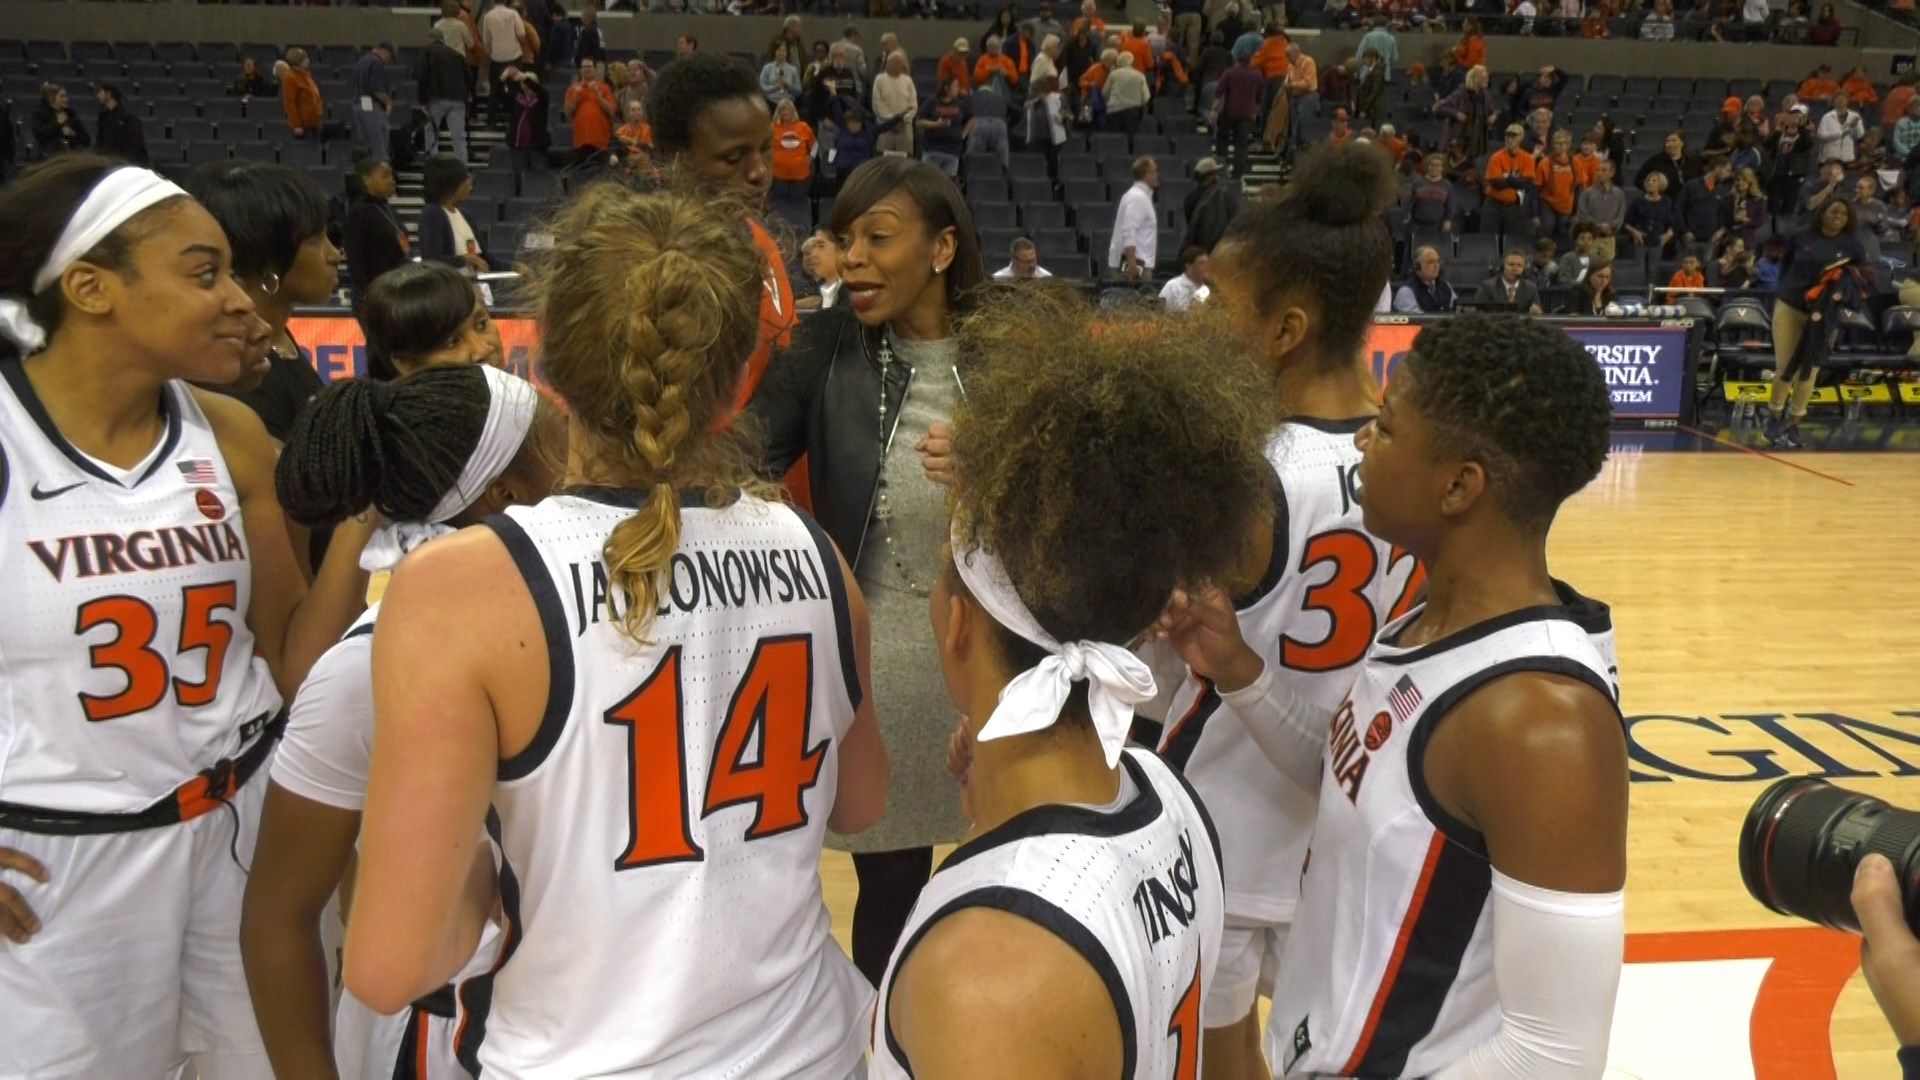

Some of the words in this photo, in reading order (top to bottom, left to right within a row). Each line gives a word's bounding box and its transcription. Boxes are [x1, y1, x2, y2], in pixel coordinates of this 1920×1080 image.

[1609, 388, 1652, 403] STEM
[27, 522, 246, 584] VIRGINIA
[569, 548, 829, 638] JAONOWSKI
[74, 579, 237, 722] 35
[603, 631, 832, 872] 14
[1628, 711, 1920, 783] GIN
